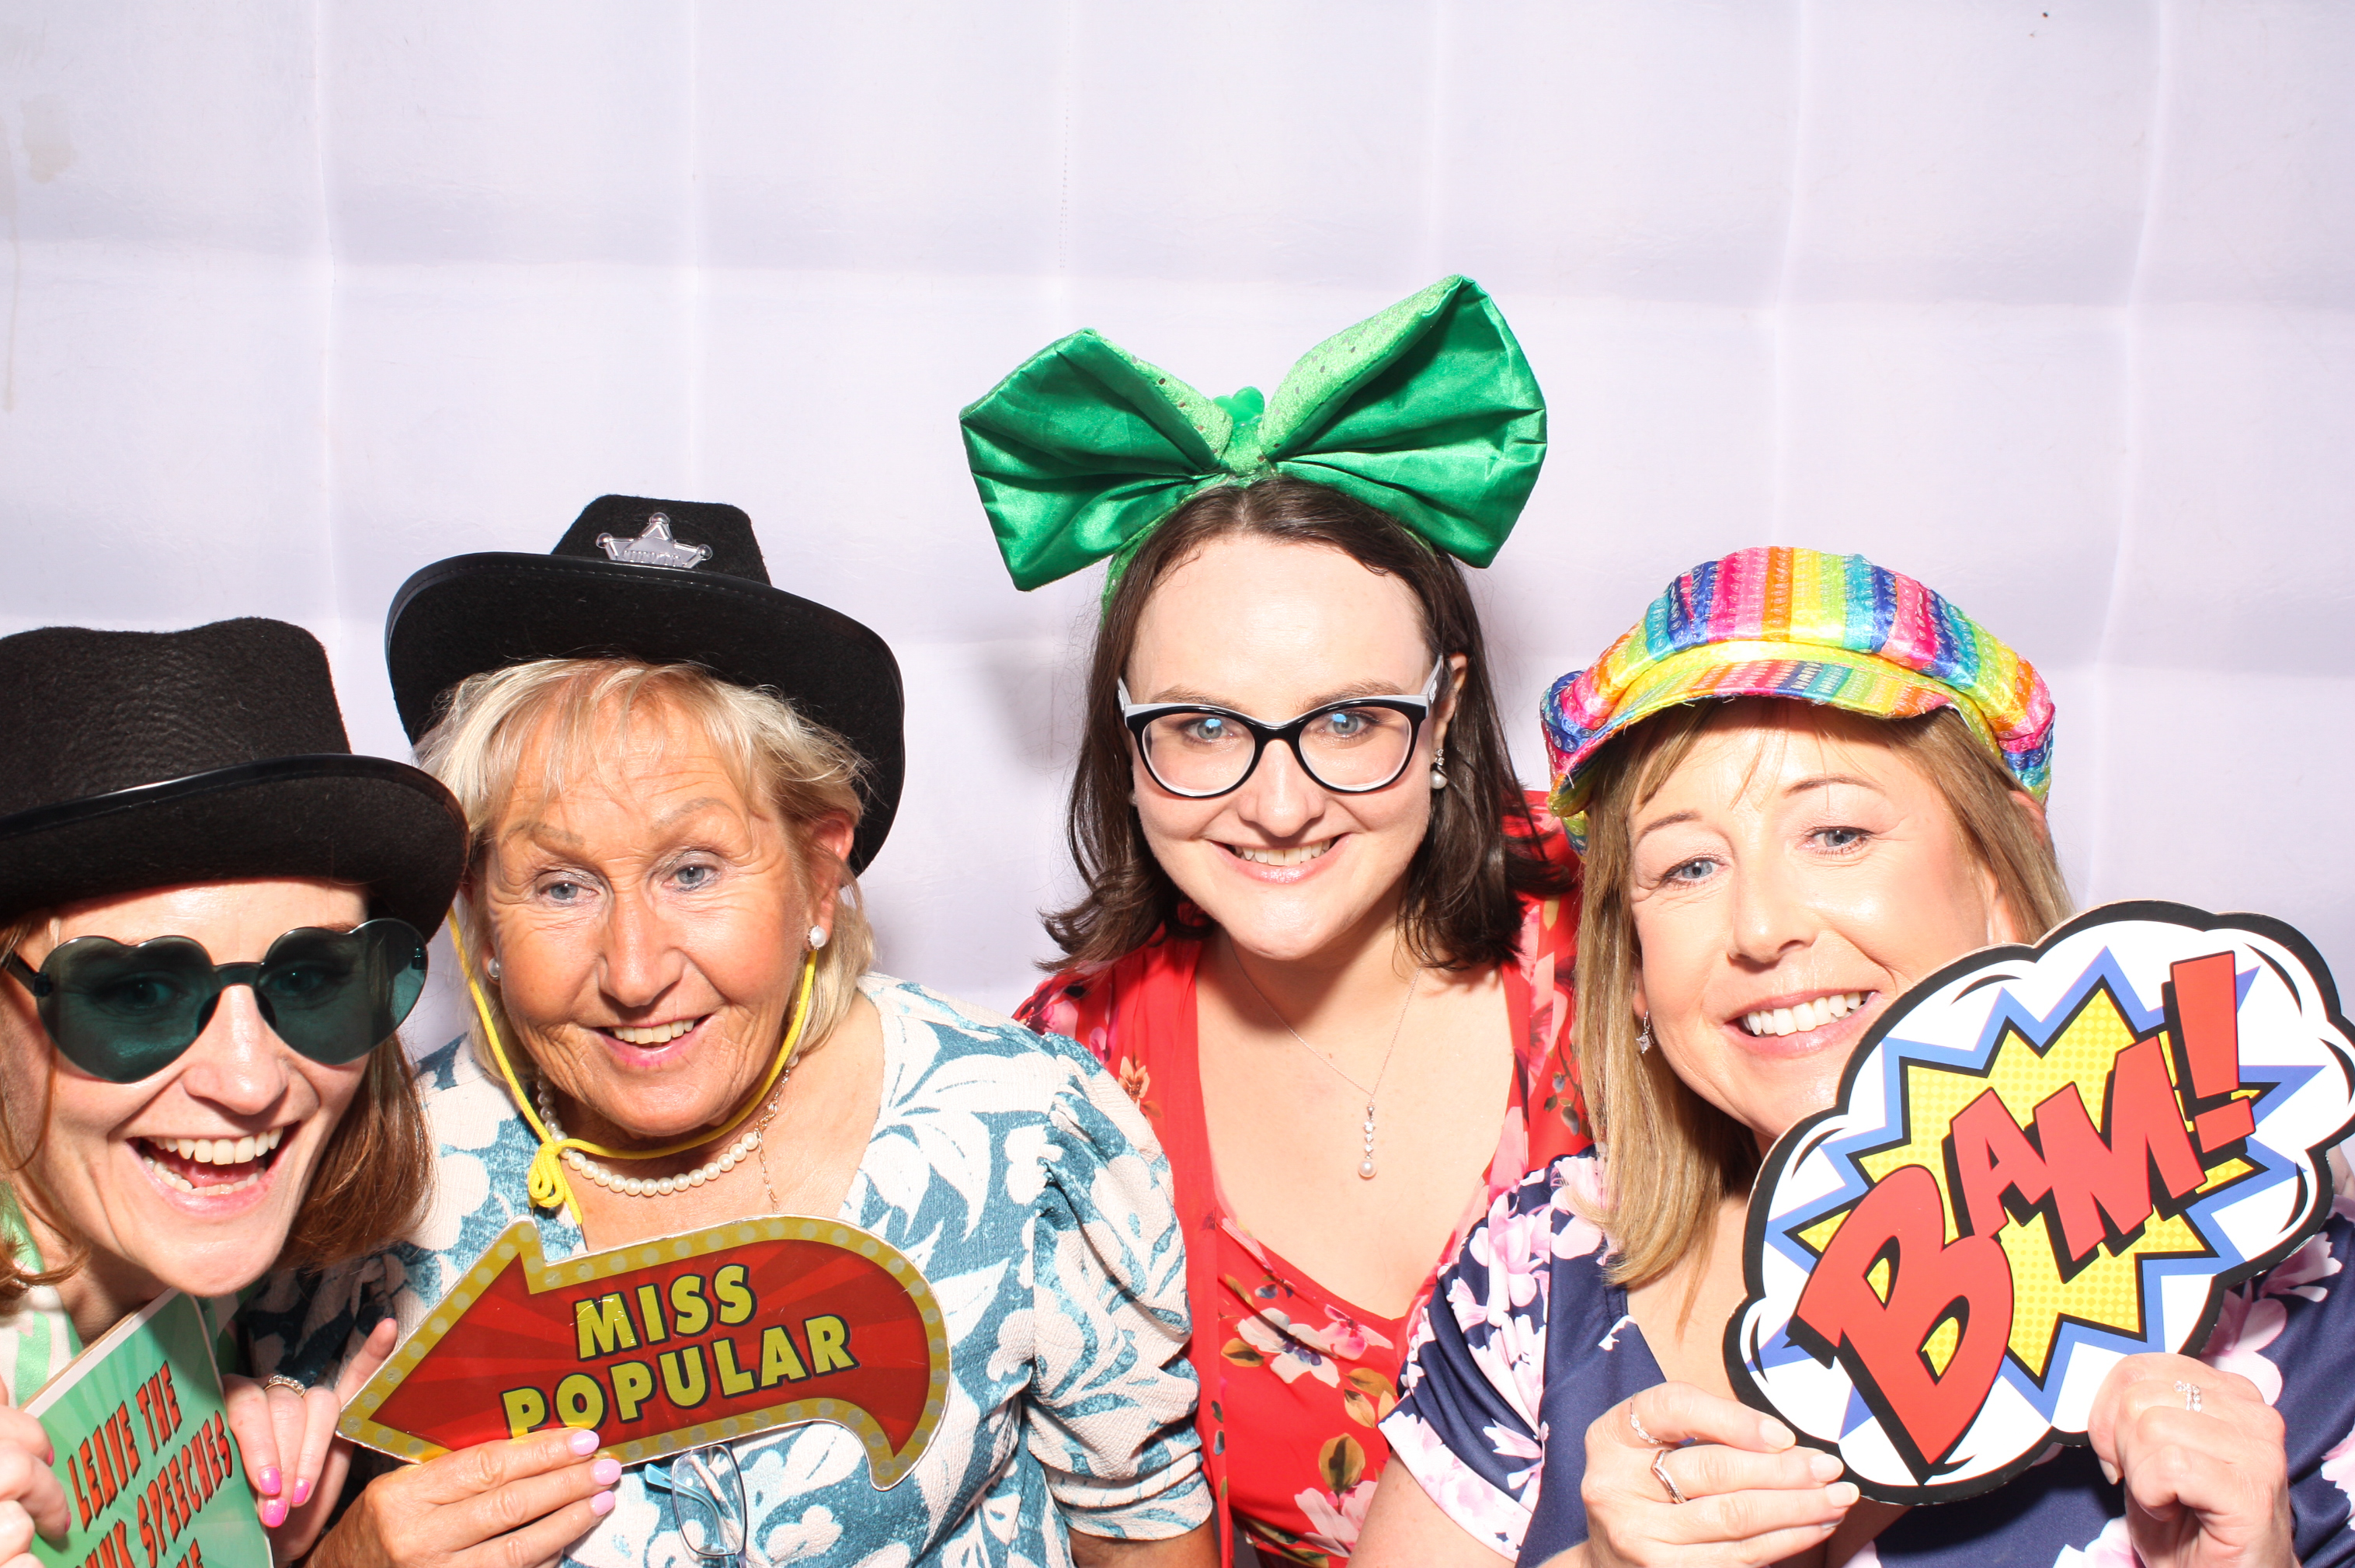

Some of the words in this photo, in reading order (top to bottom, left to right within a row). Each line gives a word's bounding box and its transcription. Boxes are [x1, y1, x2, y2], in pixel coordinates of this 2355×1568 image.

[1786, 950, 2256, 1483] BAM!
[503, 1313, 860, 1438] POPULAR
[573, 1264, 757, 1361] MISS
[68, 1400, 141, 1534] LEAVE
[135, 1360, 183, 1456] THE
[137, 1410, 232, 1568] SPEECHES
